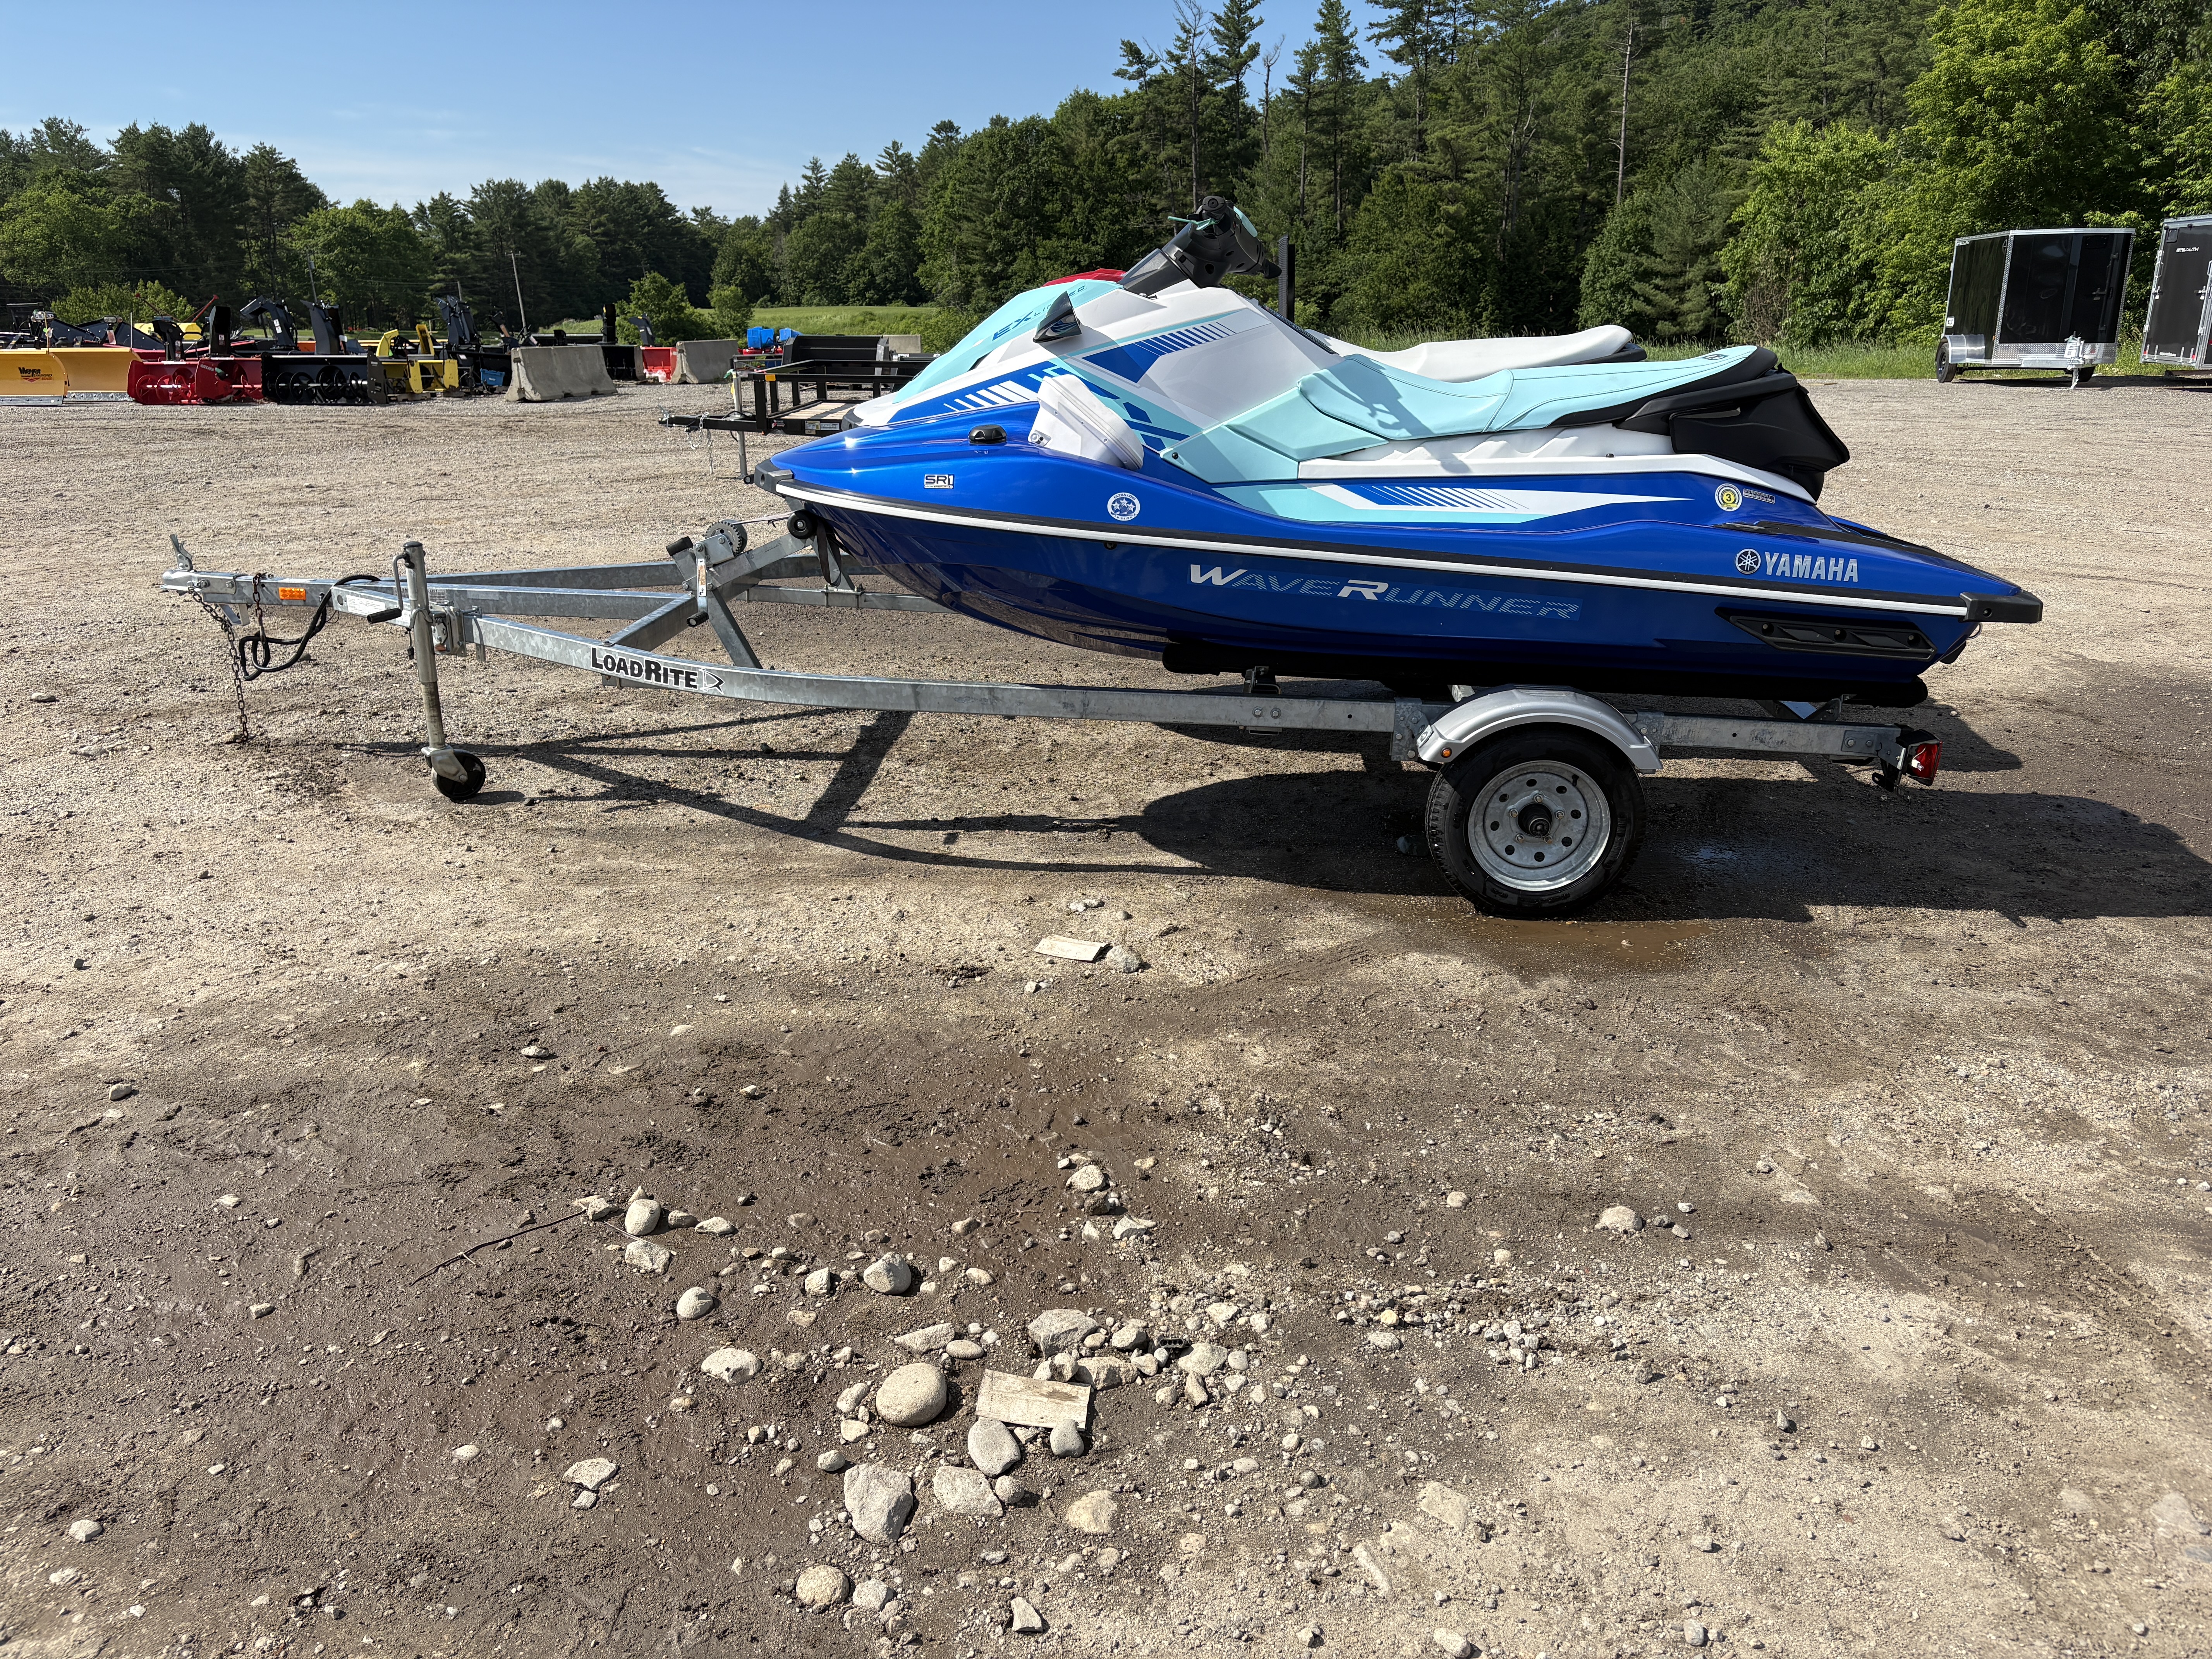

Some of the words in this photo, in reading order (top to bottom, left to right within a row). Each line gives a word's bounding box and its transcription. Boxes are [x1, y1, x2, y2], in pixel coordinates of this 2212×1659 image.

[992, 311, 1033, 341] EX
[1034, 285, 1085, 316] LIED
[926, 475, 953, 484] SR1
[1726, 493, 1731, 501] 3
[1765, 551, 1858, 582] YAMAHA
